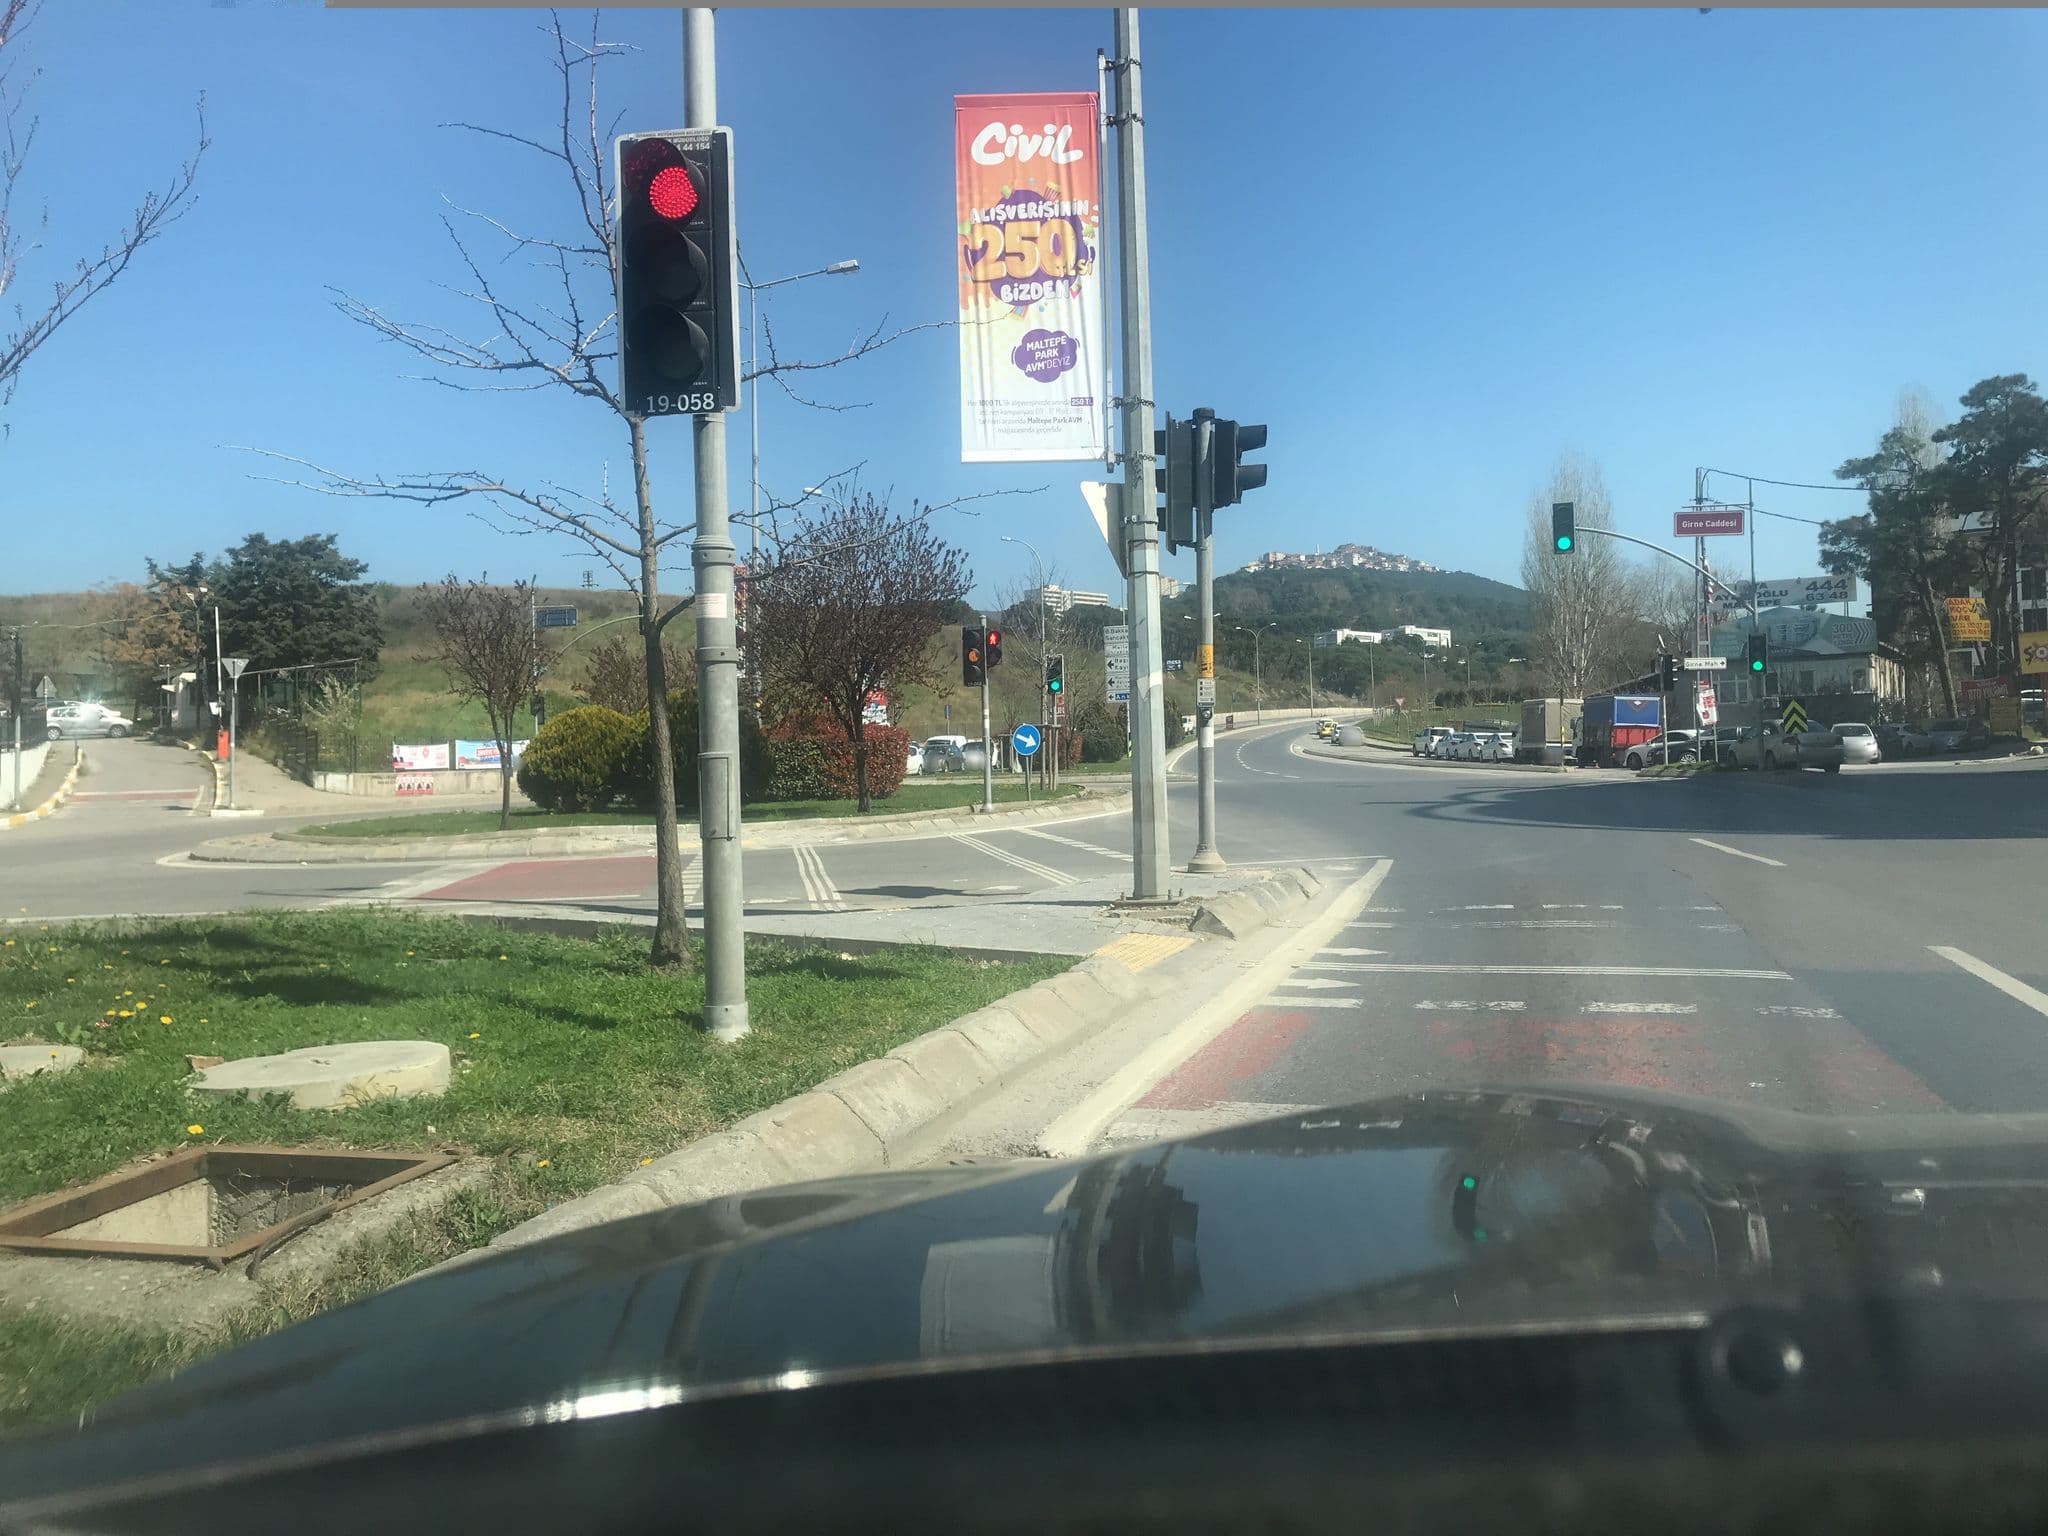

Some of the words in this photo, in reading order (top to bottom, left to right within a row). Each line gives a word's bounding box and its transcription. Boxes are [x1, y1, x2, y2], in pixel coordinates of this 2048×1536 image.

[972, 218, 1077, 282] 250
[1000, 279, 1070, 303] BİZDEN
[1026, 335, 1067, 352] MALTEPE
[1035, 347, 1059, 361] PARK
[646, 392, 715, 413] 19-058
[1071, 397, 1083, 406] 250
[1027, 417, 1051, 426] Maltepe
[1682, 520, 1704, 528] Girne
[1705, 518, 1737, 528] Caddesi
[1806, 579, 1848, 591] 444
[1806, 593, 1825, 601] 63
[1829, 591, 1849, 600] 48
